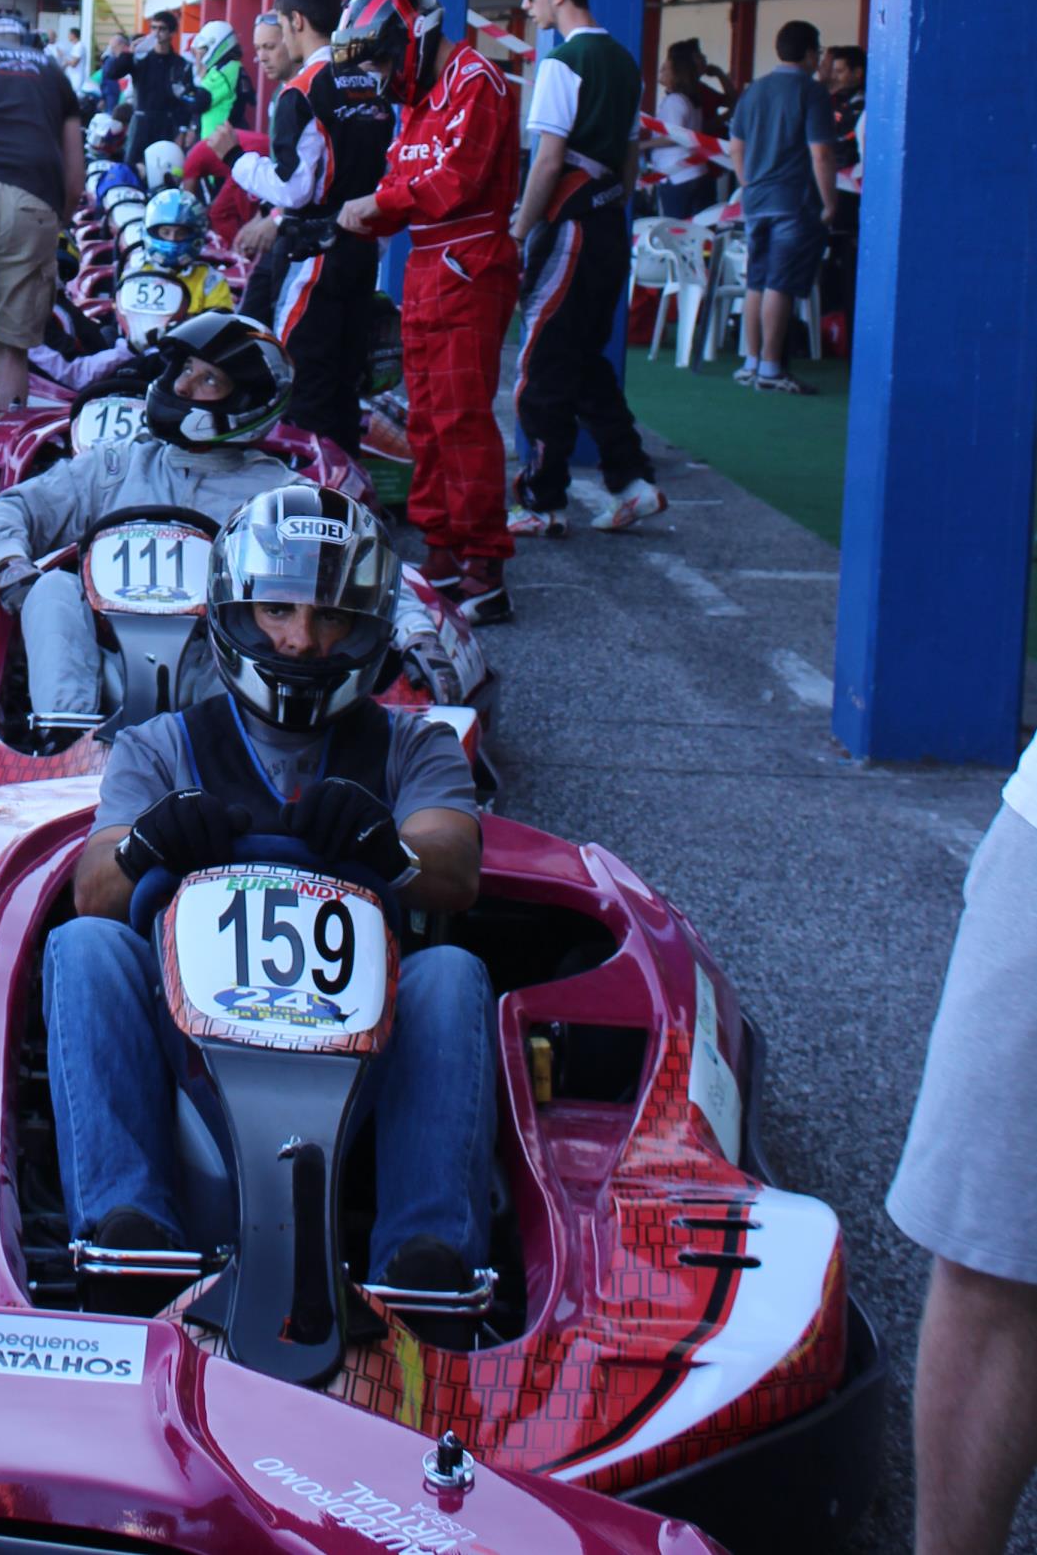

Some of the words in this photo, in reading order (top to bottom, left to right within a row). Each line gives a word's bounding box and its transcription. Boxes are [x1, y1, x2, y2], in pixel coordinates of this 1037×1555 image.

[136, 283, 165, 306] 52
[289, 520, 344, 540] SHOEI
[112, 537, 184, 588] 111
[218, 888, 356, 995] 159
[233, 986, 314, 1012] 24
[341, 1480, 458, 1554] VIRTUAL
[411, 1501, 477, 1542] LISBOA
